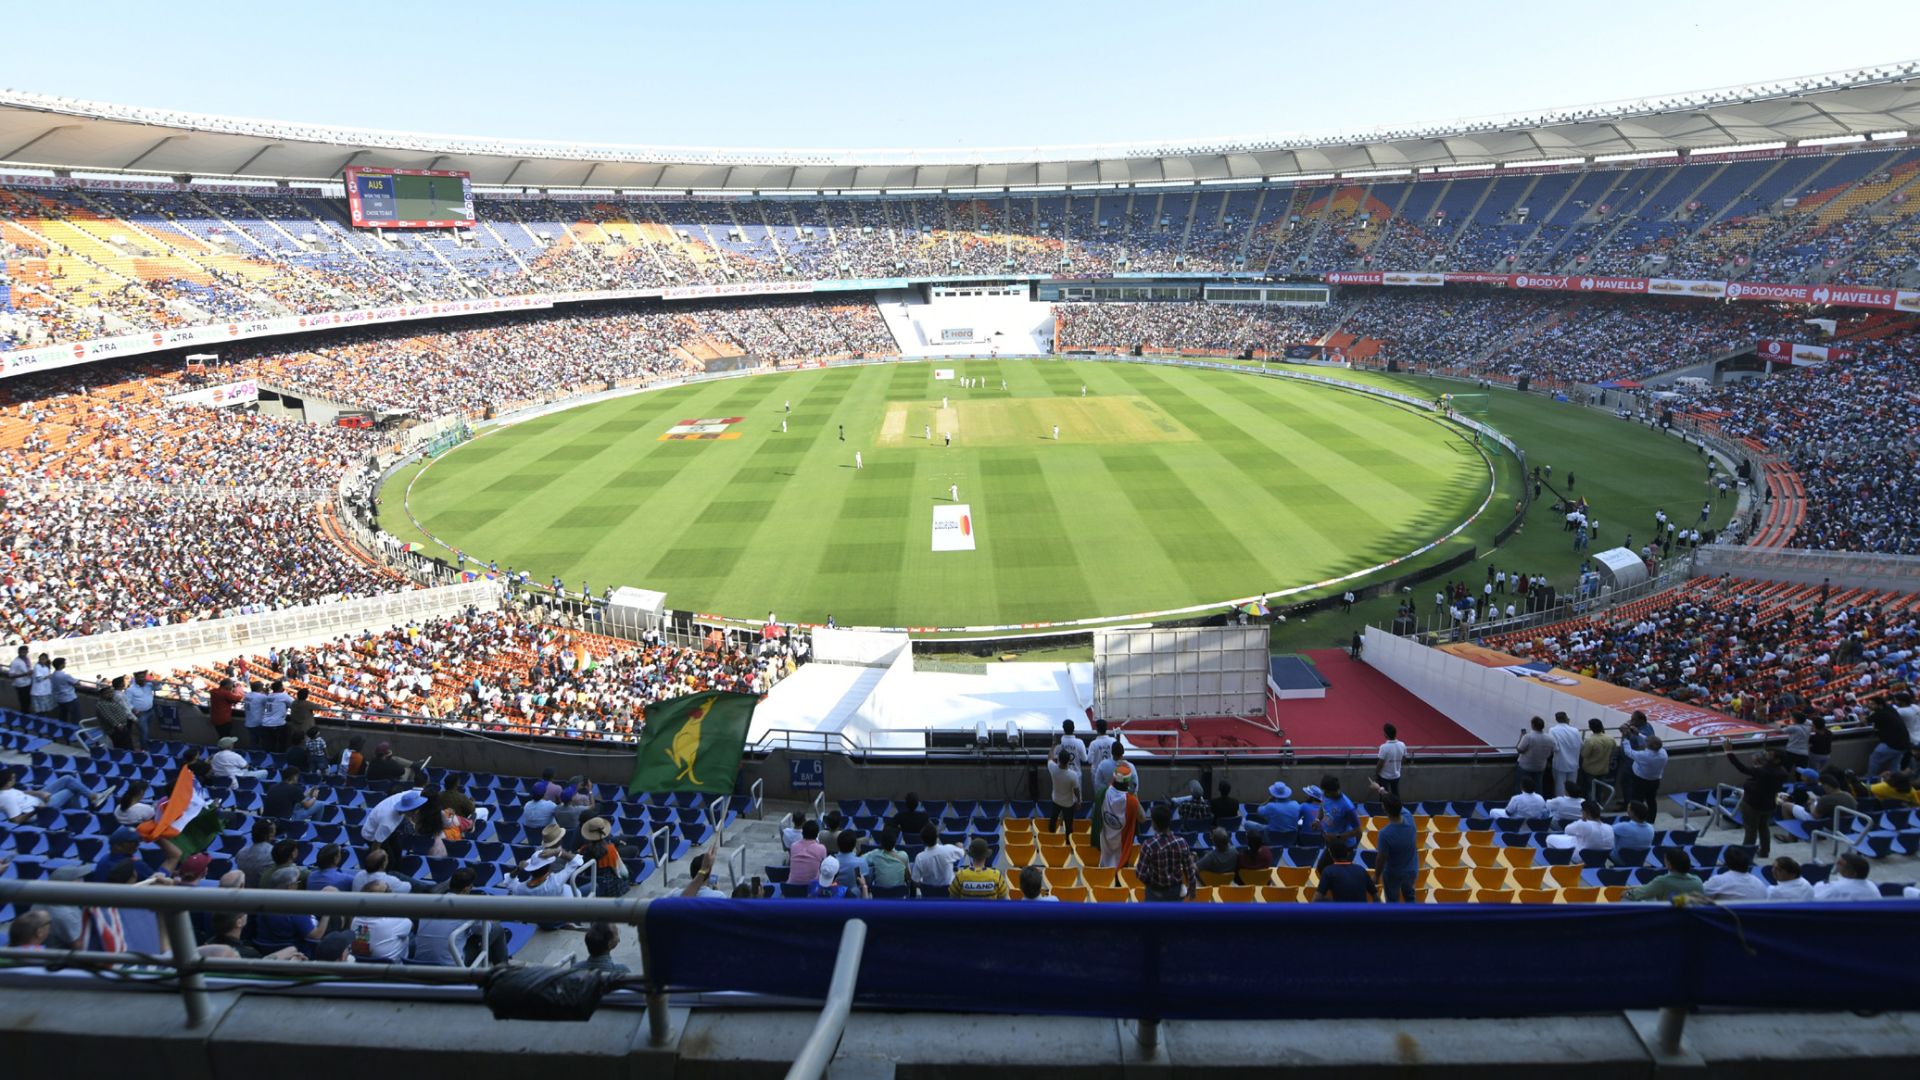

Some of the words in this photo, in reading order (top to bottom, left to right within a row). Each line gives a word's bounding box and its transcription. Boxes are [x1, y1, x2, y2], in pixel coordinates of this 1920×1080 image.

[368, 181, 383, 189] AUS
[1340, 274, 1380, 282] HAVELLS
[1596, 280, 1644, 290] HAVELLS
[1742, 286, 1807, 299] BODYCARE
[1832, 291, 1891, 305] HAVELLS
[792, 760, 800, 773] 7
[814, 760, 822, 774] 6
